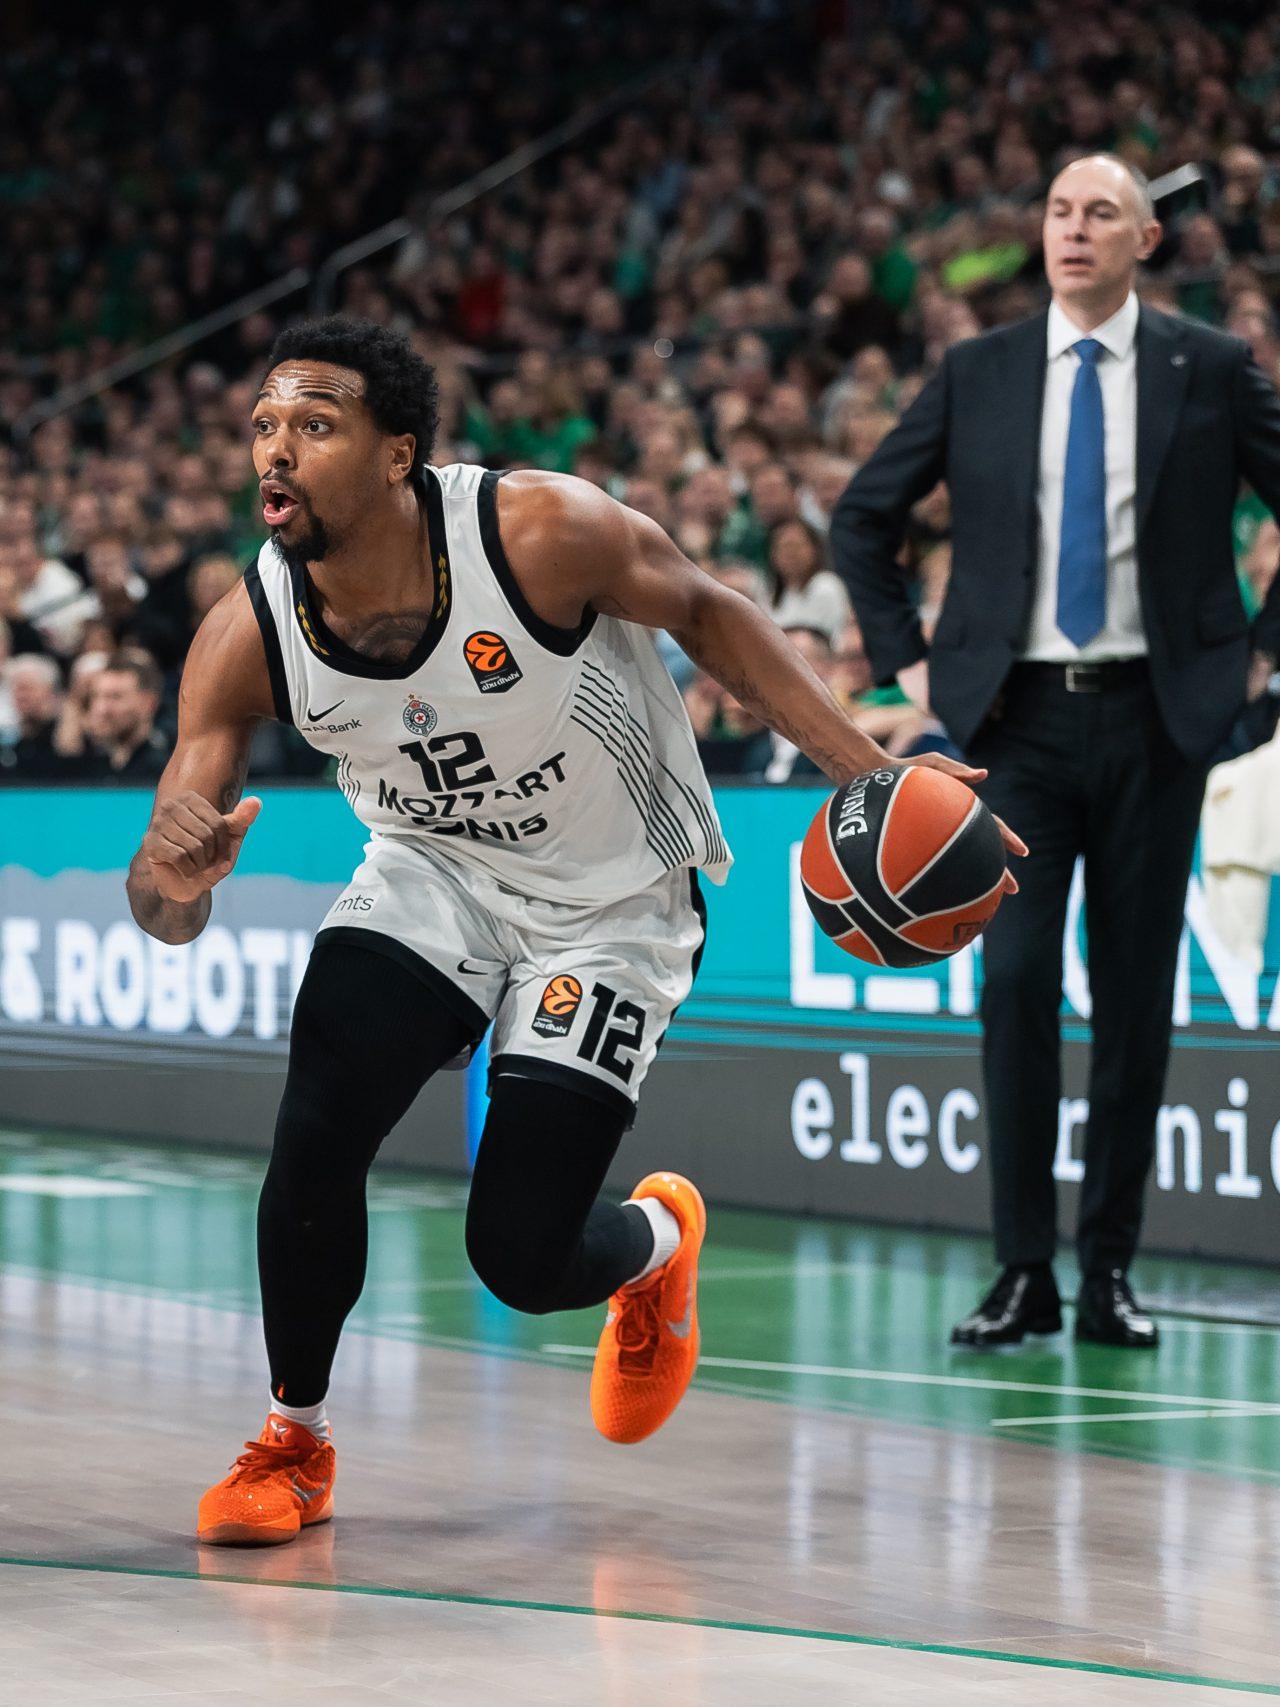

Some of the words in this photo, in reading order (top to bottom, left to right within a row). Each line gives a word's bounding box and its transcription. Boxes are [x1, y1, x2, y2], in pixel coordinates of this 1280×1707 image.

[397, 731, 497, 792] 12
[334, 894, 375, 912] mts
[0, 916, 44, 1022] &
[576, 981, 647, 1087] 12
